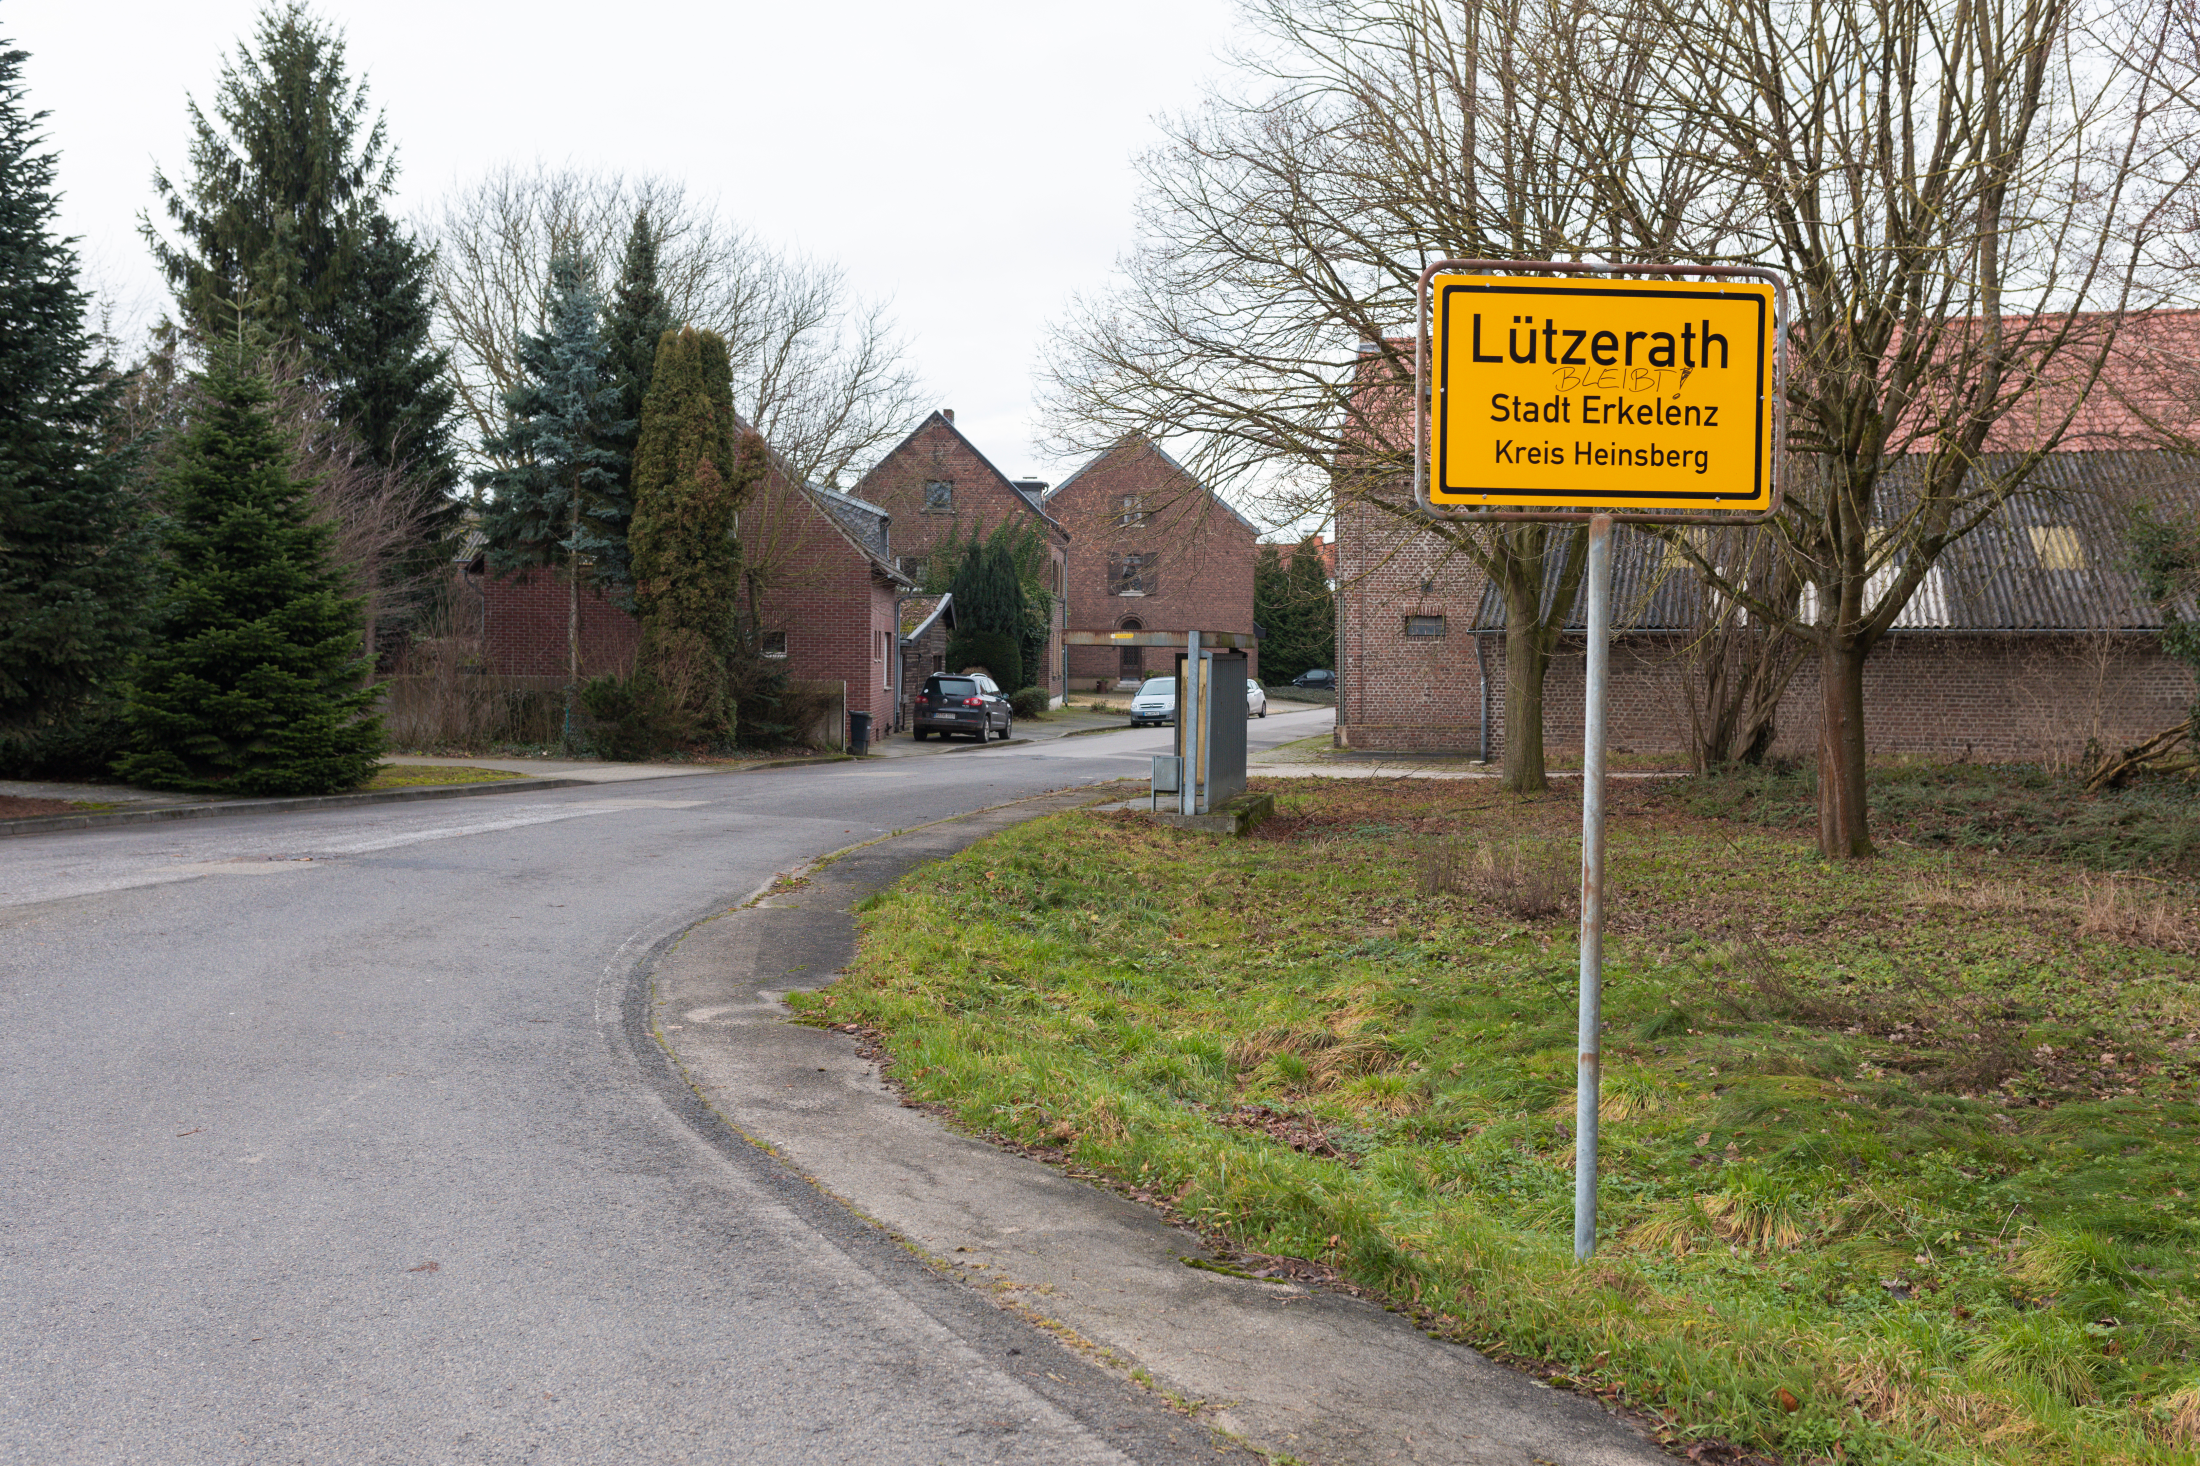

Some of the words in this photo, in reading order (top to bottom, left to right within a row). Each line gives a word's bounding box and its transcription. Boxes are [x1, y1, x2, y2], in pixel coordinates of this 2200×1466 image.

[1472, 313, 1729, 369] Lützerath
[1552, 366, 1694, 400] BLEIBT!
[1490, 393, 1571, 423] Stadt
[1582, 395, 1719, 427] Erkelenz
[1495, 439, 1565, 465] Kreis
[1574, 441, 1709, 474] Heinsberg
